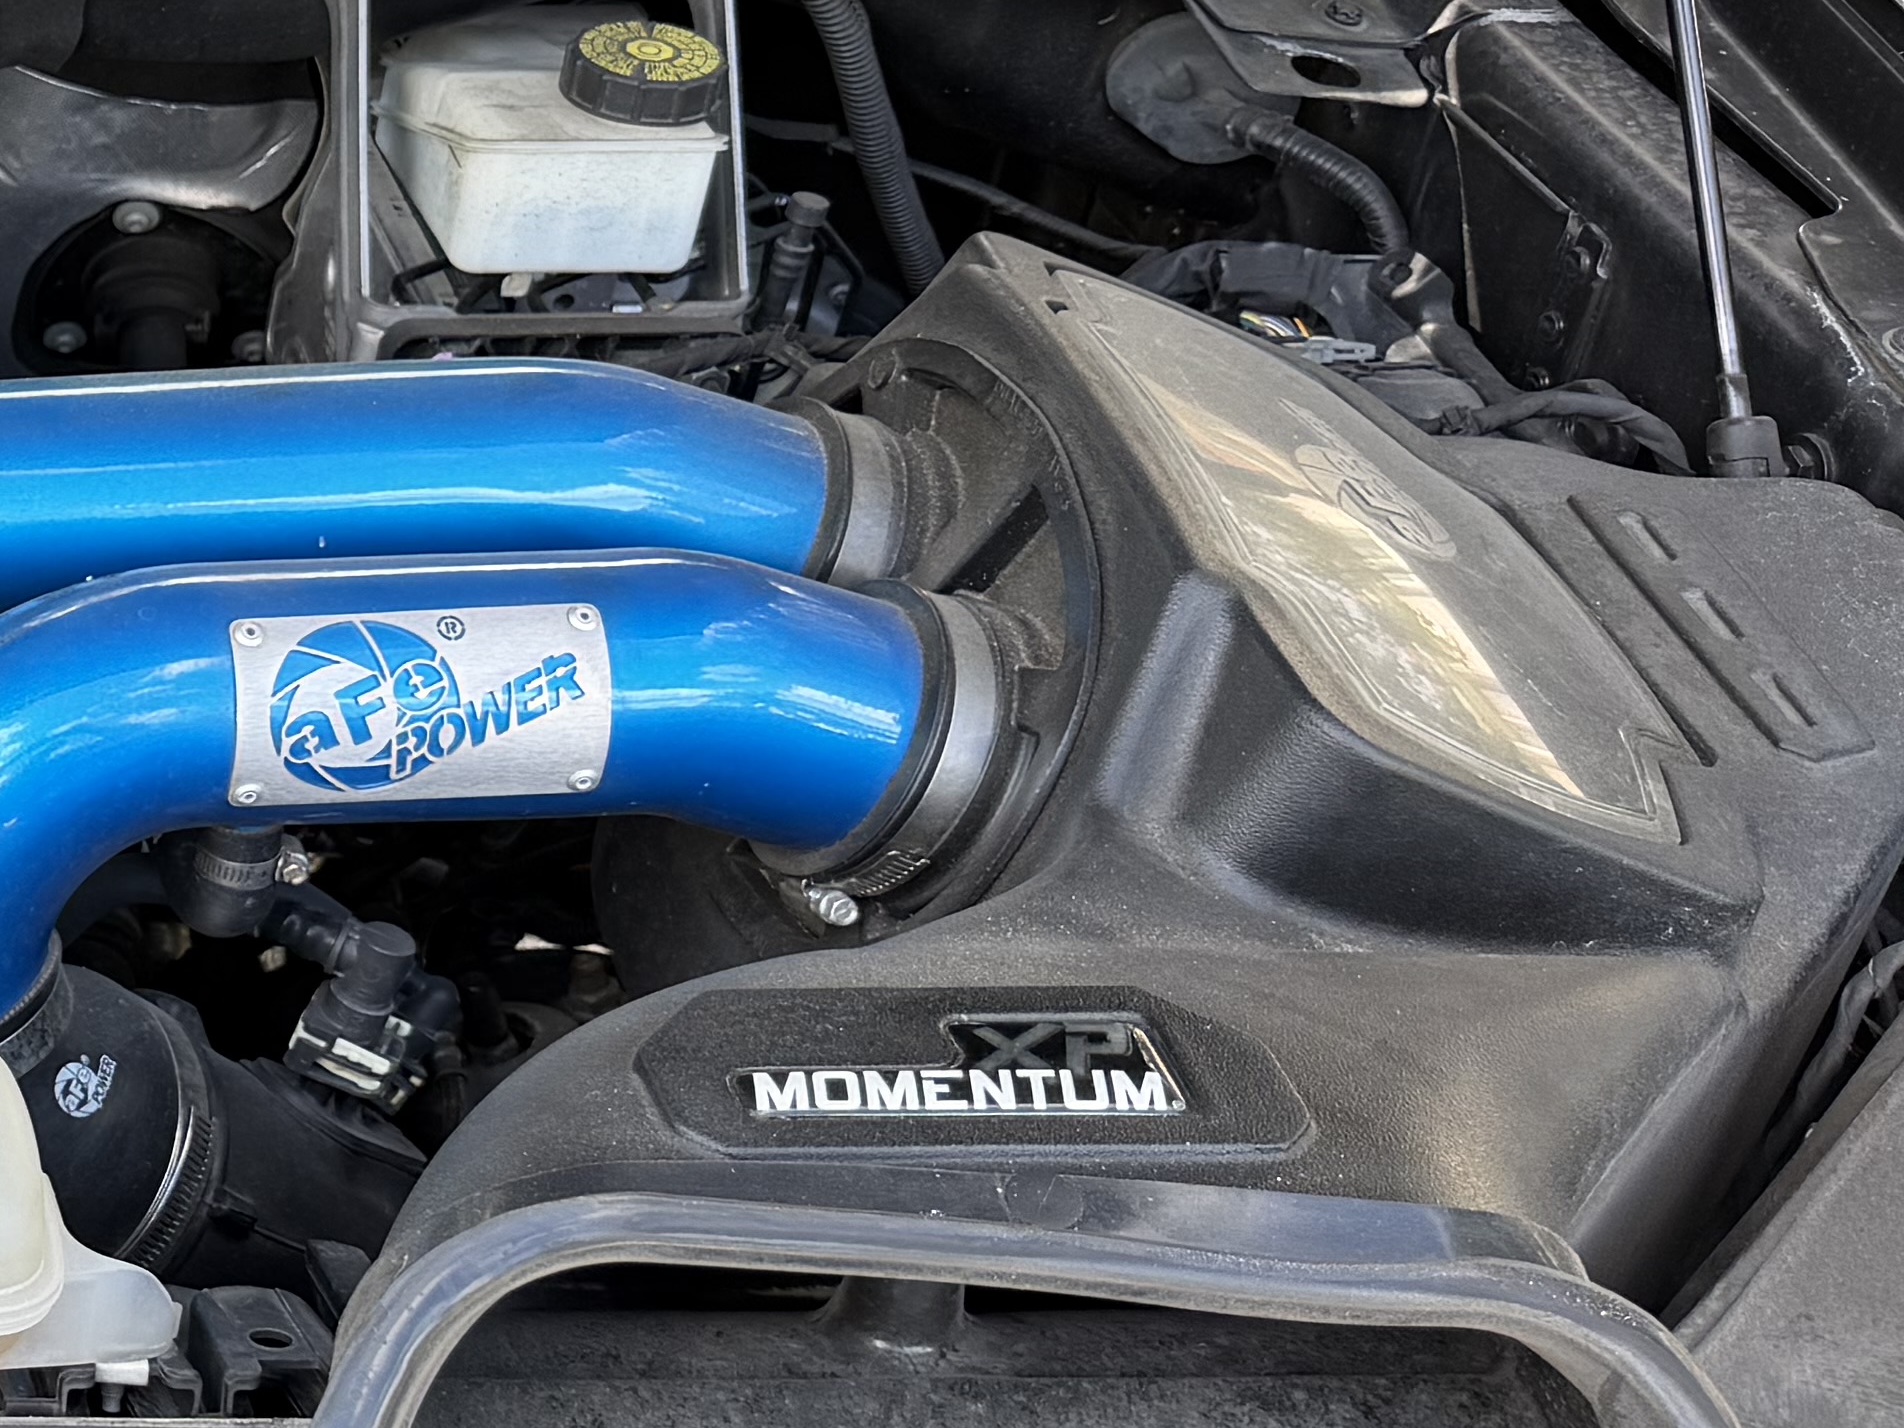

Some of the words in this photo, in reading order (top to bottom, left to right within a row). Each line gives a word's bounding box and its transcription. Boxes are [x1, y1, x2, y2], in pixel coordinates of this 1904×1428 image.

[393, 652, 587, 777] POWER
[972, 1023, 1134, 1077] XP
[92, 1055, 117, 1107] POWER
[754, 1068, 1169, 1111] MOMENTUM
